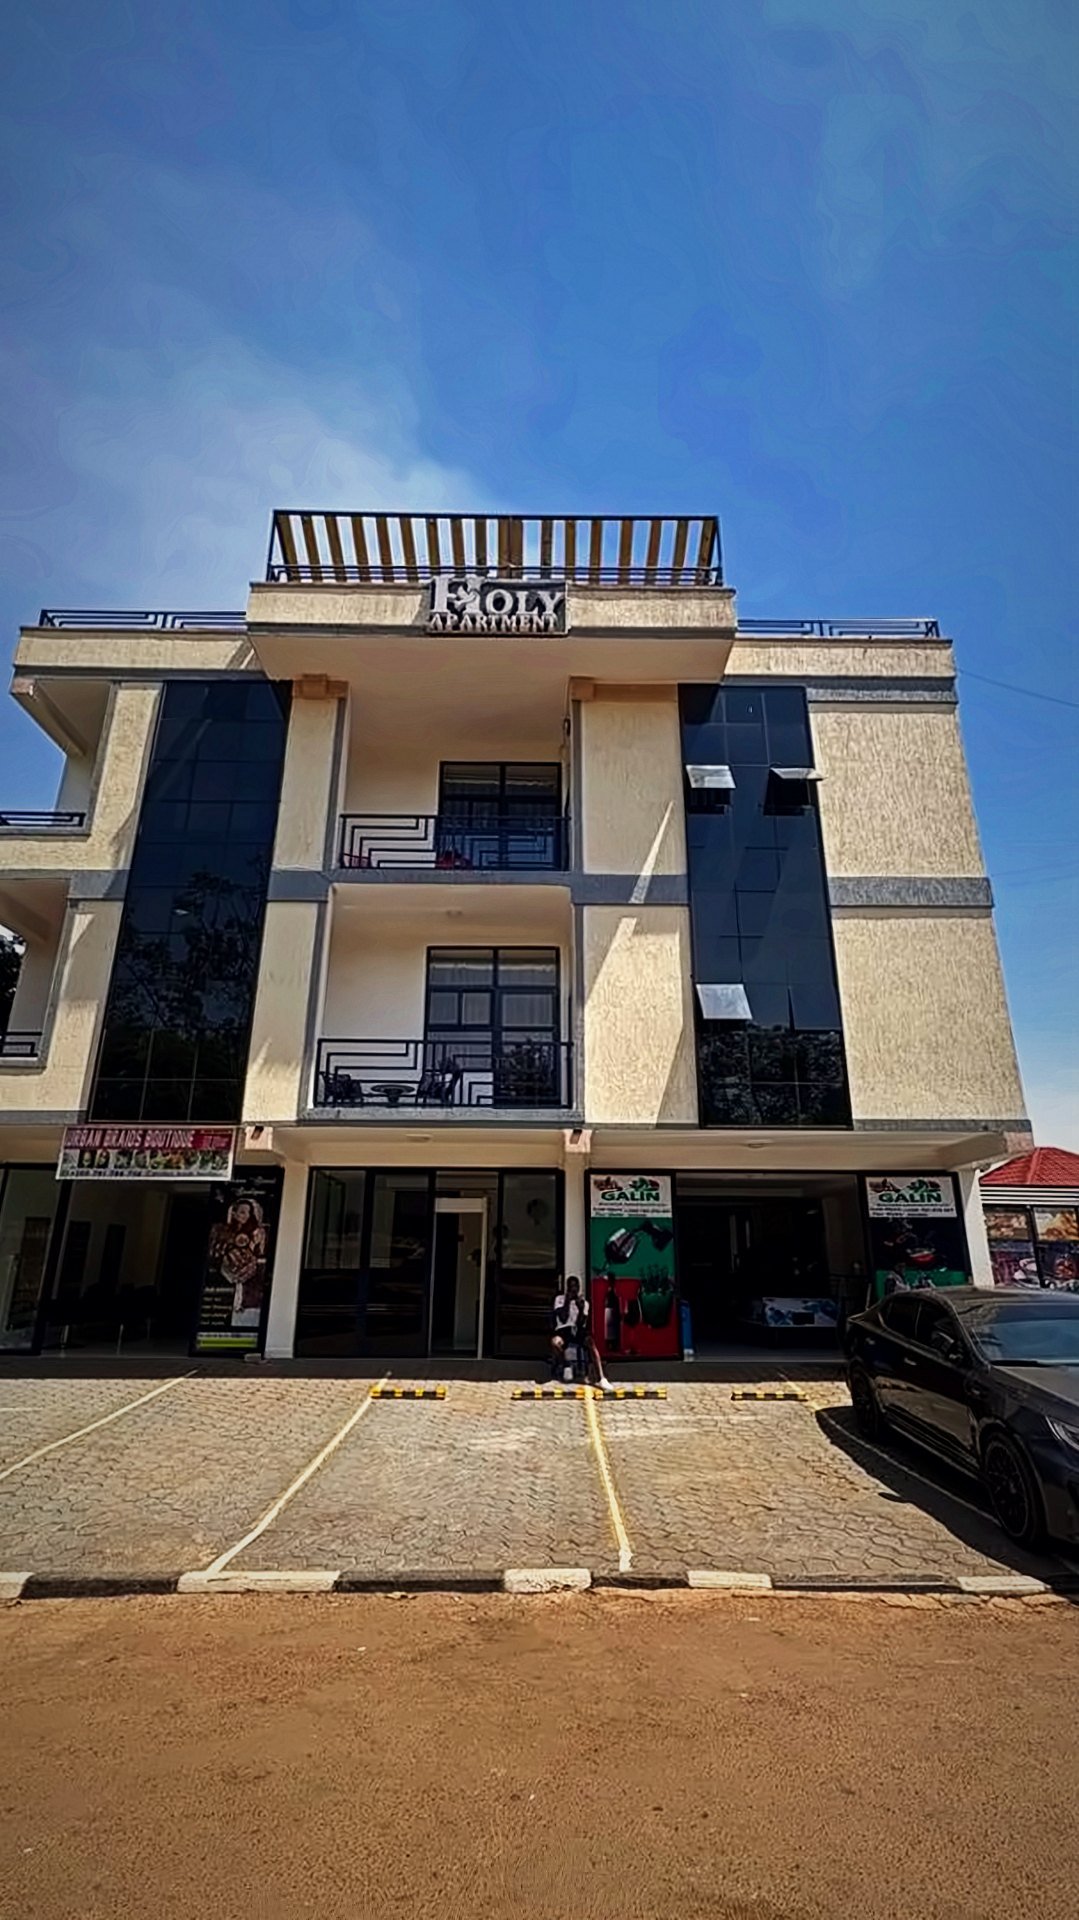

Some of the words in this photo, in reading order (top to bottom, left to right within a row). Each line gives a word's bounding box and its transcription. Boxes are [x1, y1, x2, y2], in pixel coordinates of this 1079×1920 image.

[431, 574, 563, 614] HOLY
[429, 613, 557, 632] APARTMENT
[65, 1129, 101, 1148] URBAN
[103, 1129, 143, 1148] BRAIDS
[144, 1129, 195, 1148] BOUTIQUE
[601, 1190, 660, 1201] GALIN
[878, 1192, 942, 1203] GALIN
